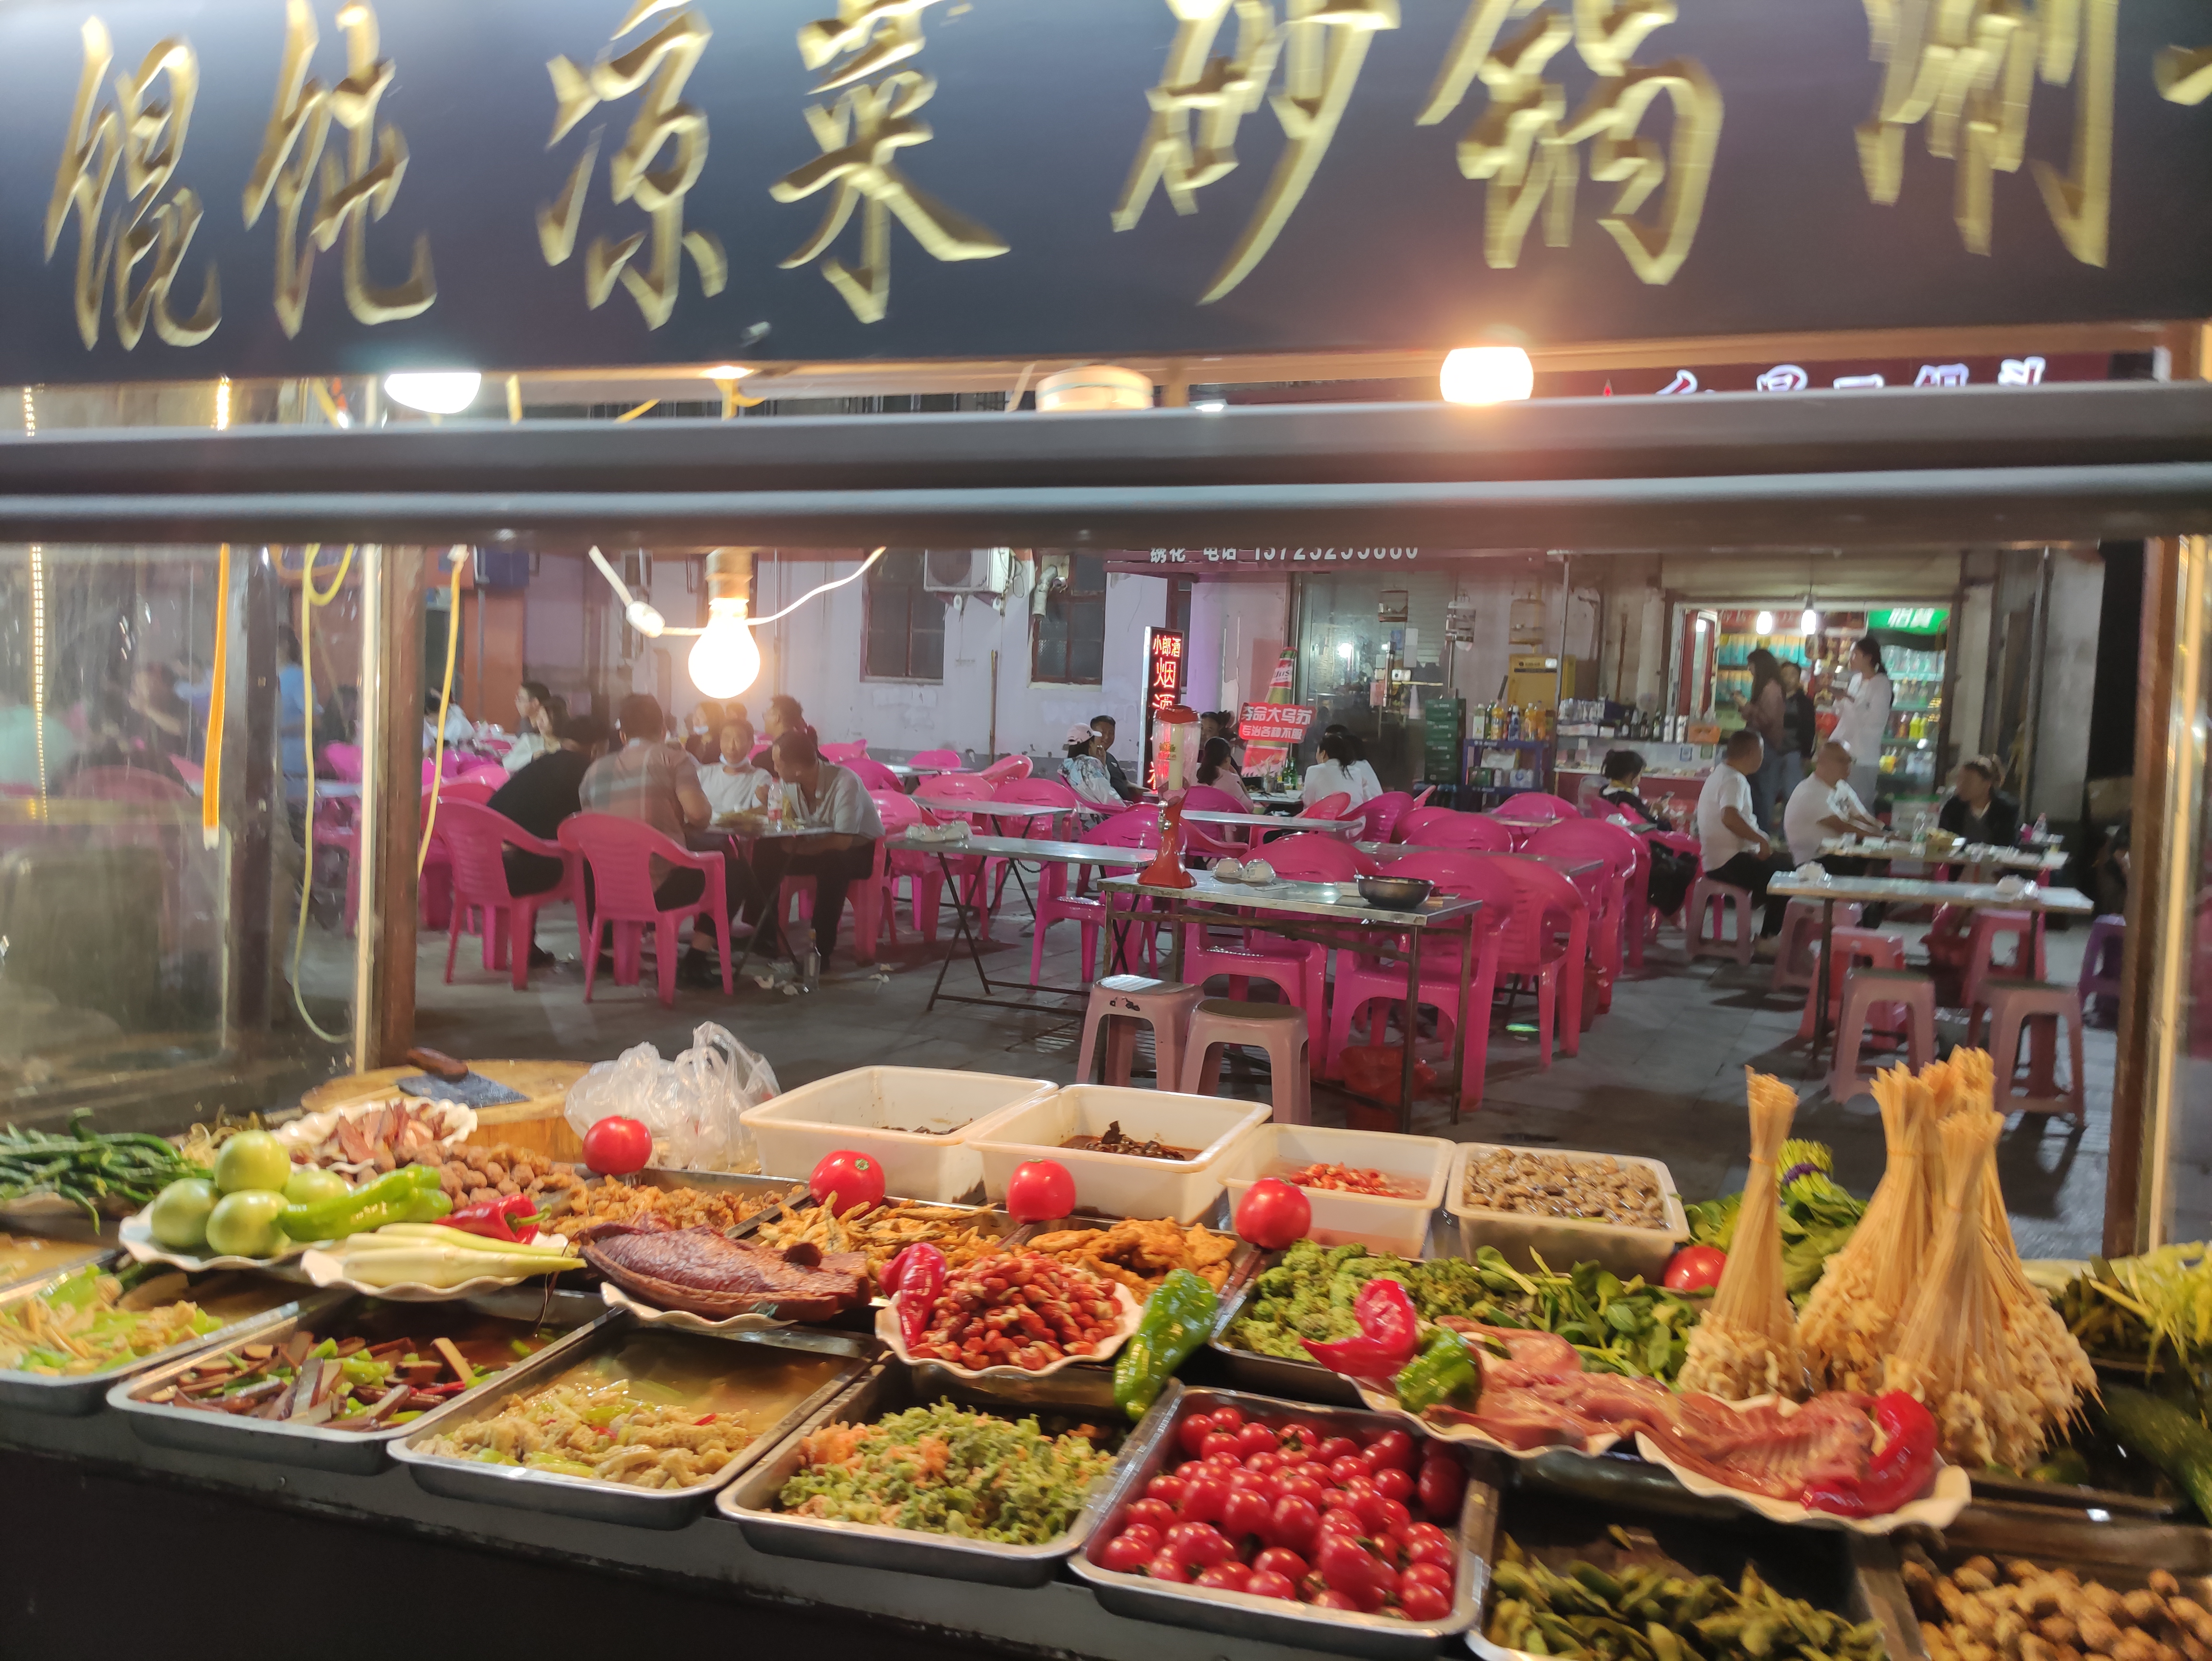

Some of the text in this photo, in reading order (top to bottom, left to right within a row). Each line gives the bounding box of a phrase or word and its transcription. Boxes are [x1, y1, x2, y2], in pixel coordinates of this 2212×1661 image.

[42, 0, 437, 352] 馄饨
[536, 0, 1011, 332] 凉菜
[1854, 0, 2212, 269] 涮
[1152, 634, 1181, 657] 小郎酒
[1241, 705, 1313, 725] 夺命大乌苏
[1242, 724, 1303, 740] 专治各种不服
